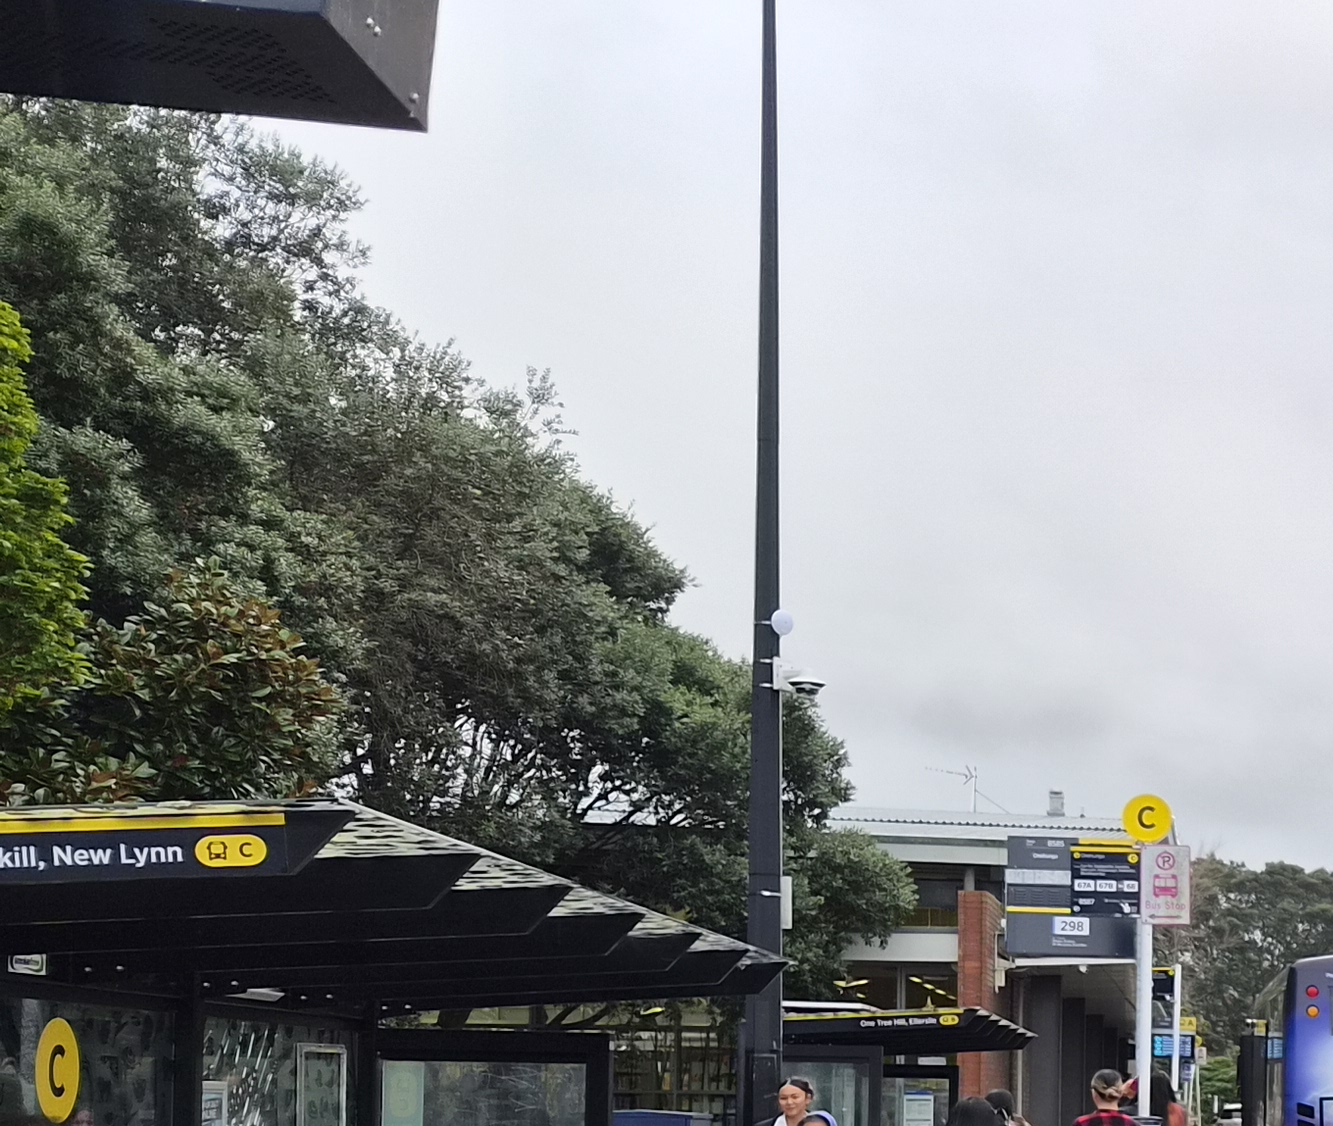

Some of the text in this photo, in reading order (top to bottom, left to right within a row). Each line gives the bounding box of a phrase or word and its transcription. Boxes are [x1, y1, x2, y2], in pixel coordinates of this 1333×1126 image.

[1137, 805, 1157, 830] C
[53, 845, 112, 867] New
[119, 843, 184, 868] Lynn
[238, 842, 253, 858] C
[1145, 900, 1161, 910] Bus
[1165, 900, 1187, 912] Stop
[1060, 920, 1084, 932] 298
[860, 1019, 876, 1028] One
[877, 1019, 892, 1027] Tree
[48, 1044, 66, 1098] C
